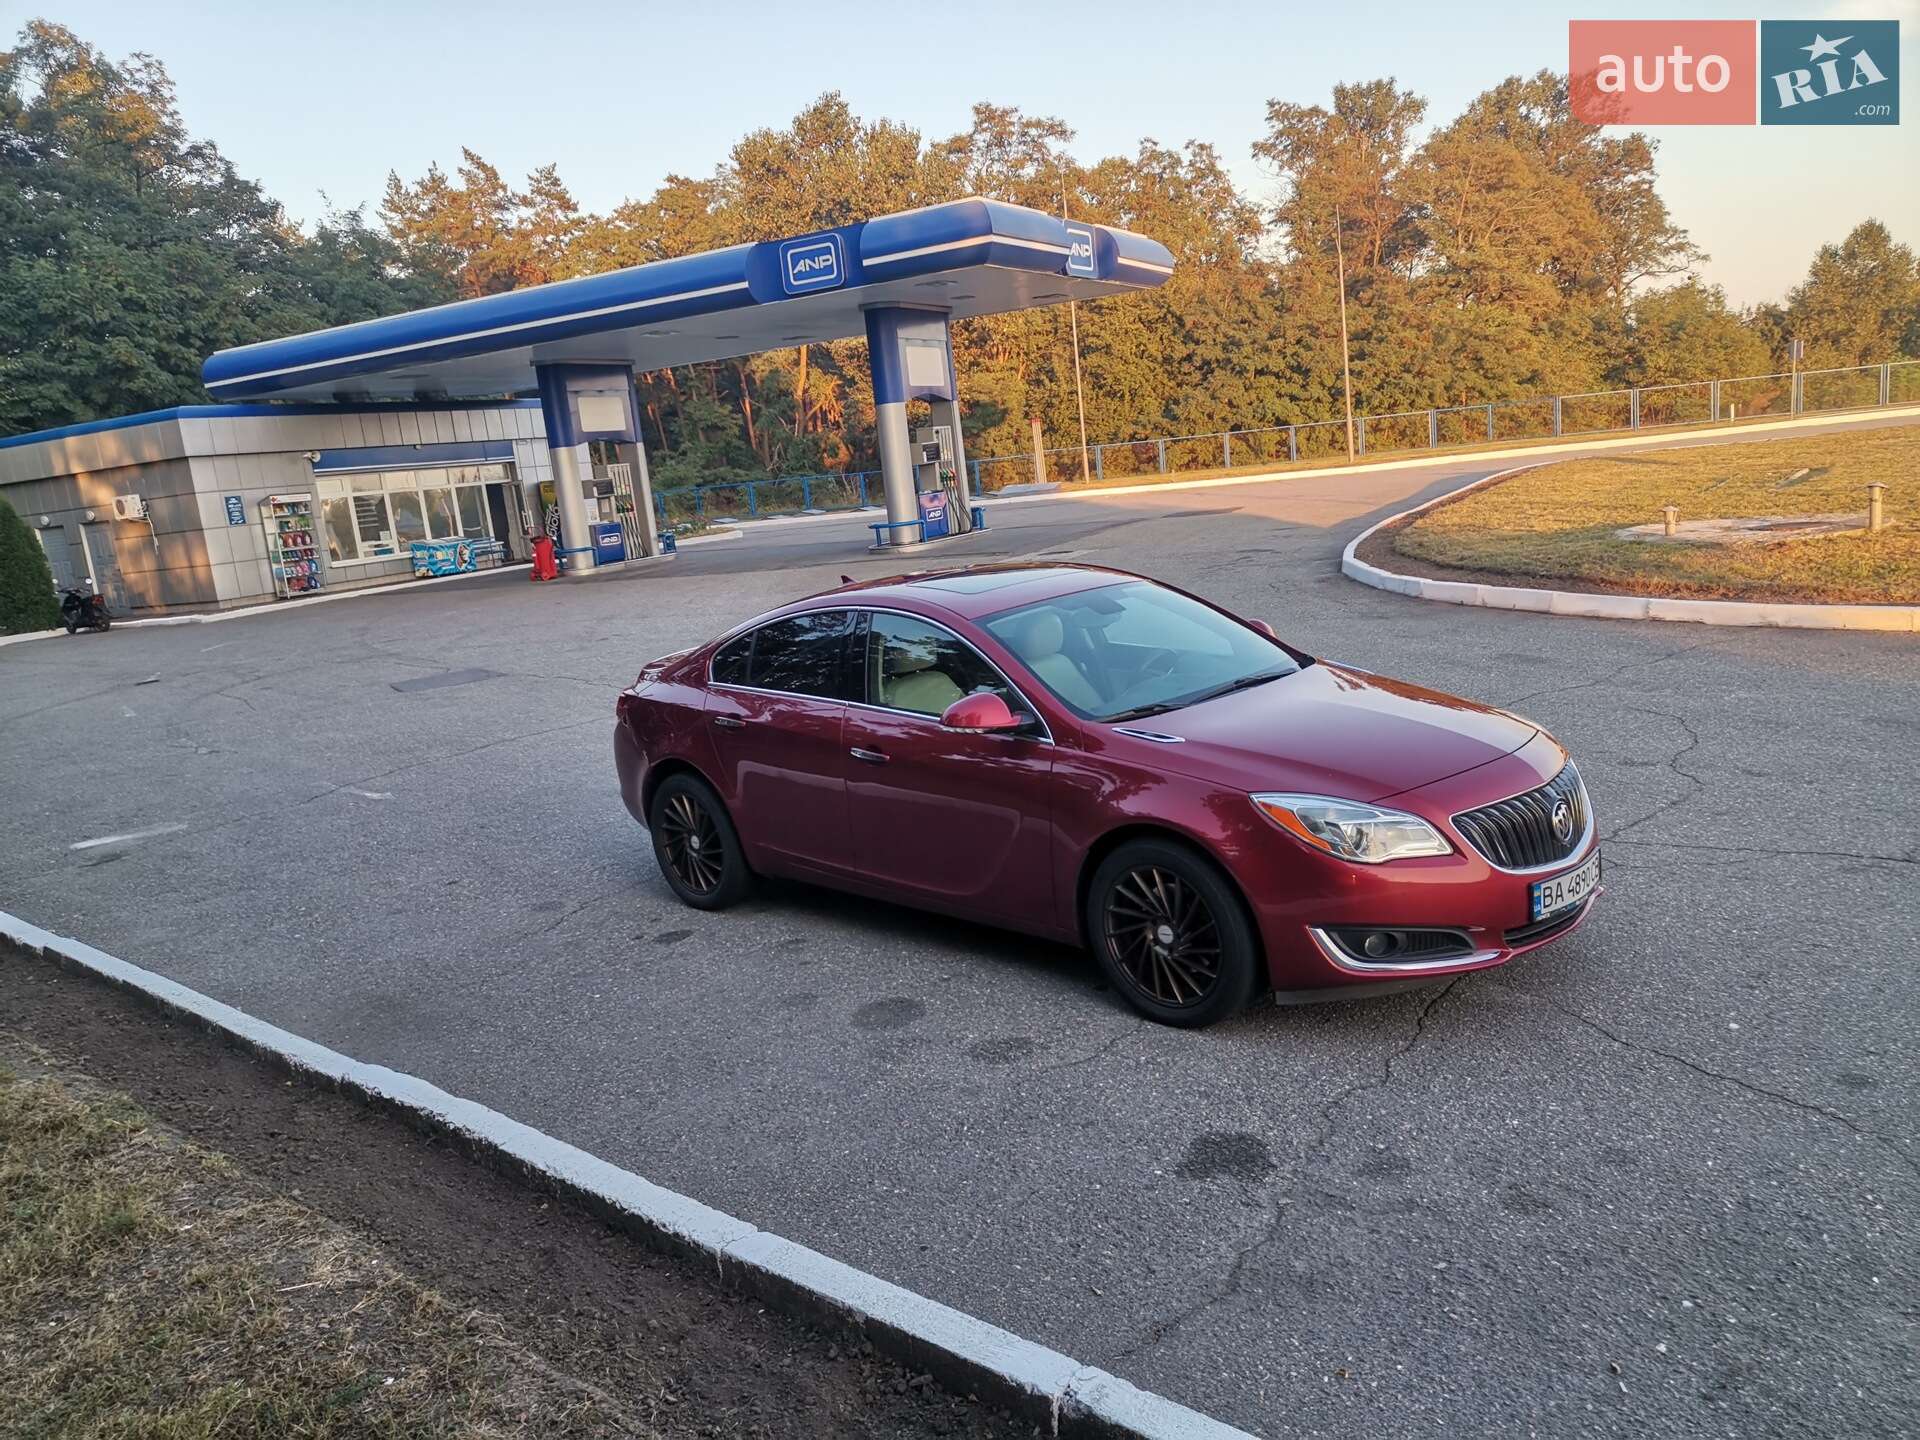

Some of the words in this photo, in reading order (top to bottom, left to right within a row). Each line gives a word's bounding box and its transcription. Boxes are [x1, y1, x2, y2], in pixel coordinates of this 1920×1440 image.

[1071, 242, 1091, 257] ANP
[793, 254, 833, 274] ANP
[1543, 882, 1564, 909] BA
[1567, 866, 1591, 897] 4890
